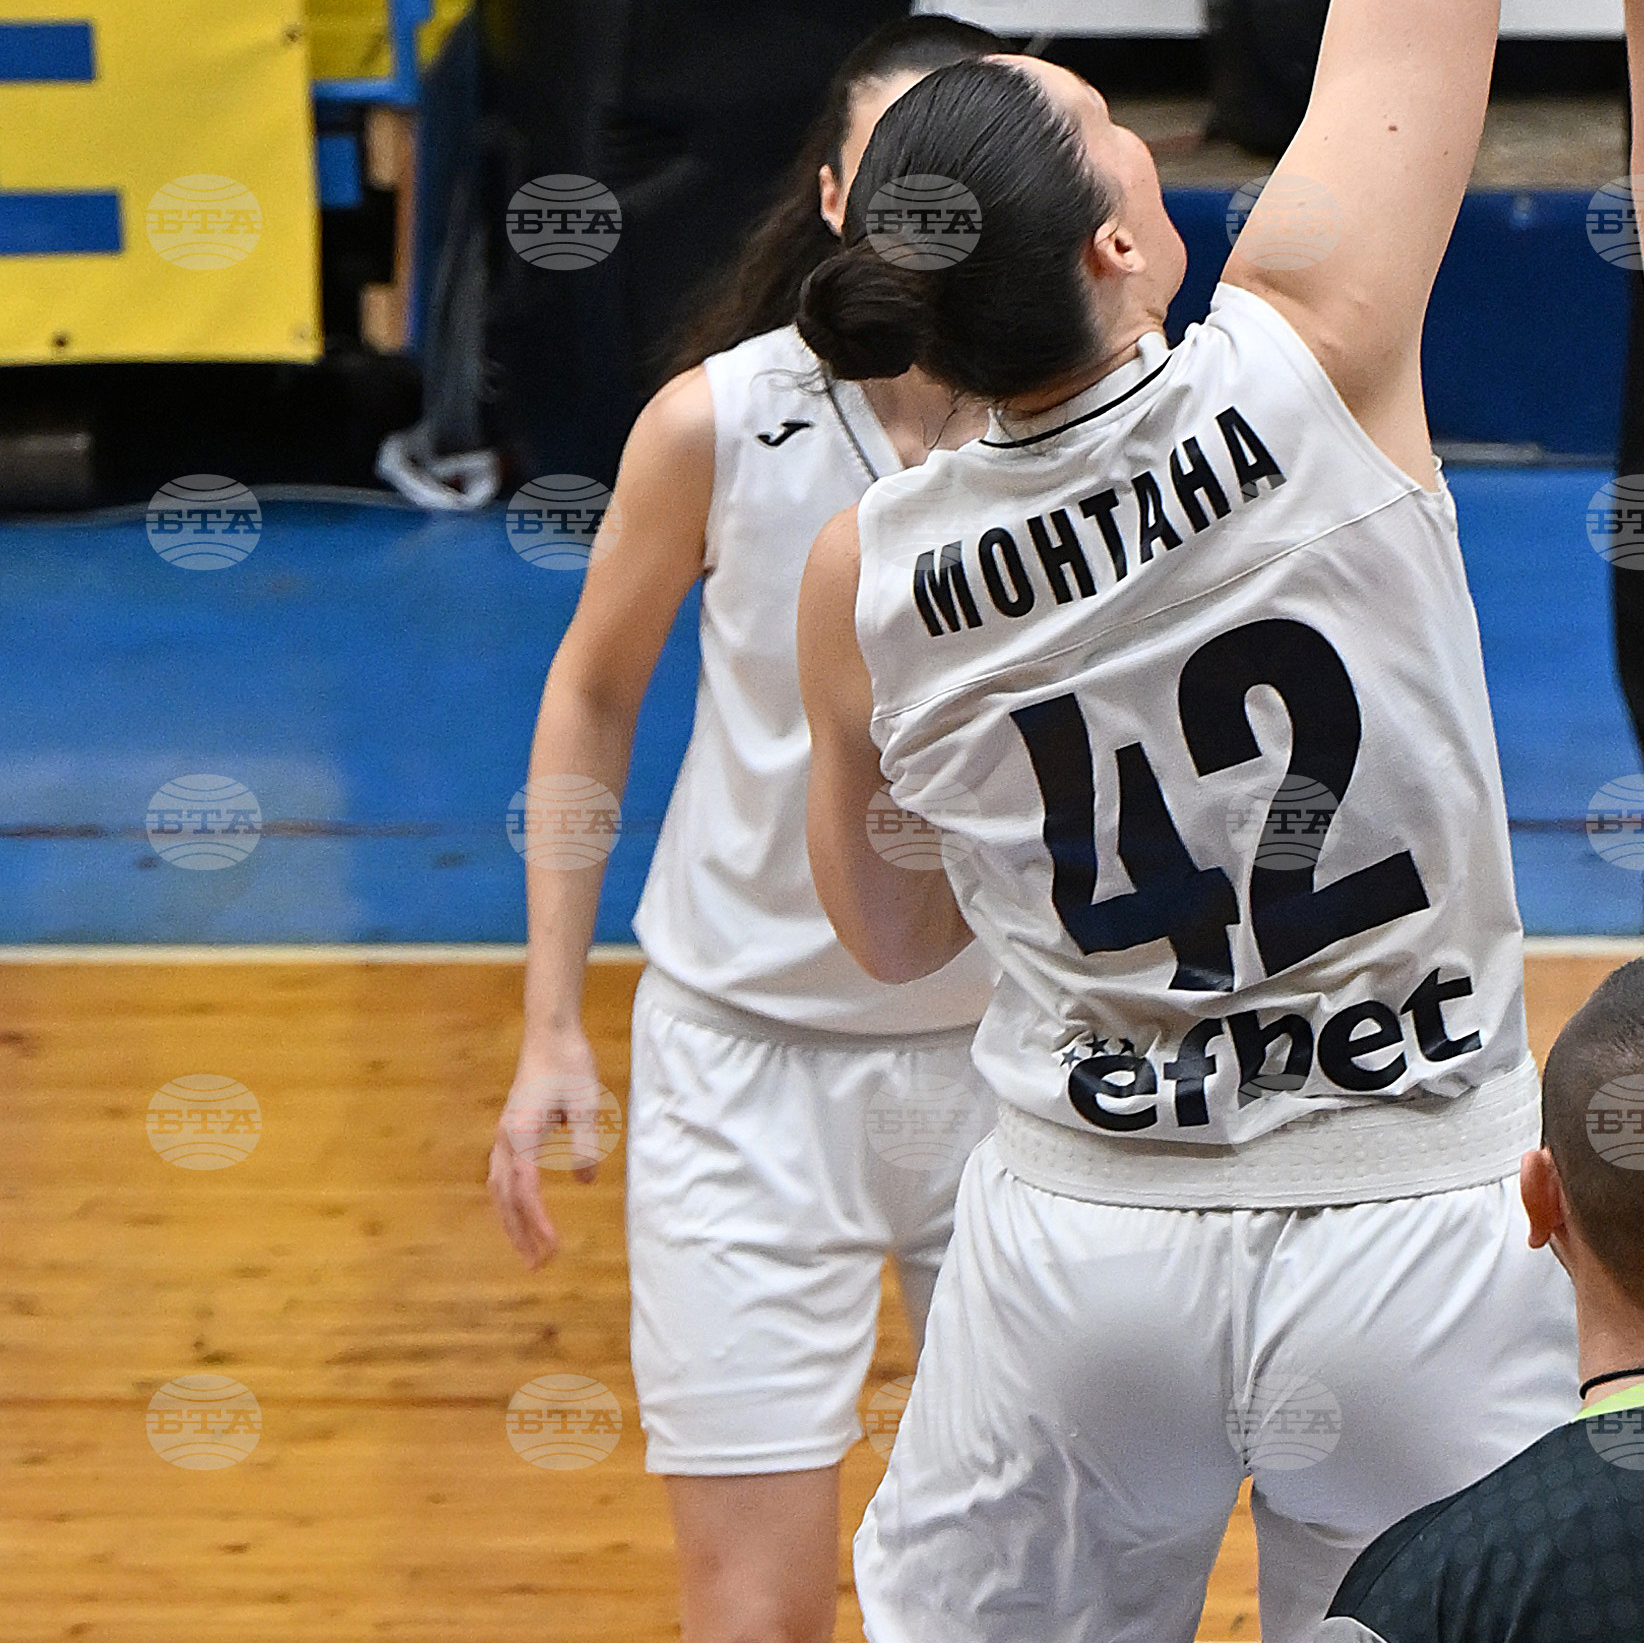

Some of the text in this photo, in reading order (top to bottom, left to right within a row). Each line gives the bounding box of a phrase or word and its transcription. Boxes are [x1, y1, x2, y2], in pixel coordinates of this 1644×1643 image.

[912, 405, 1288, 638] МОНТАНА
[1009, 618, 1431, 993] 42
[1065, 966, 1483, 1133] efbet
